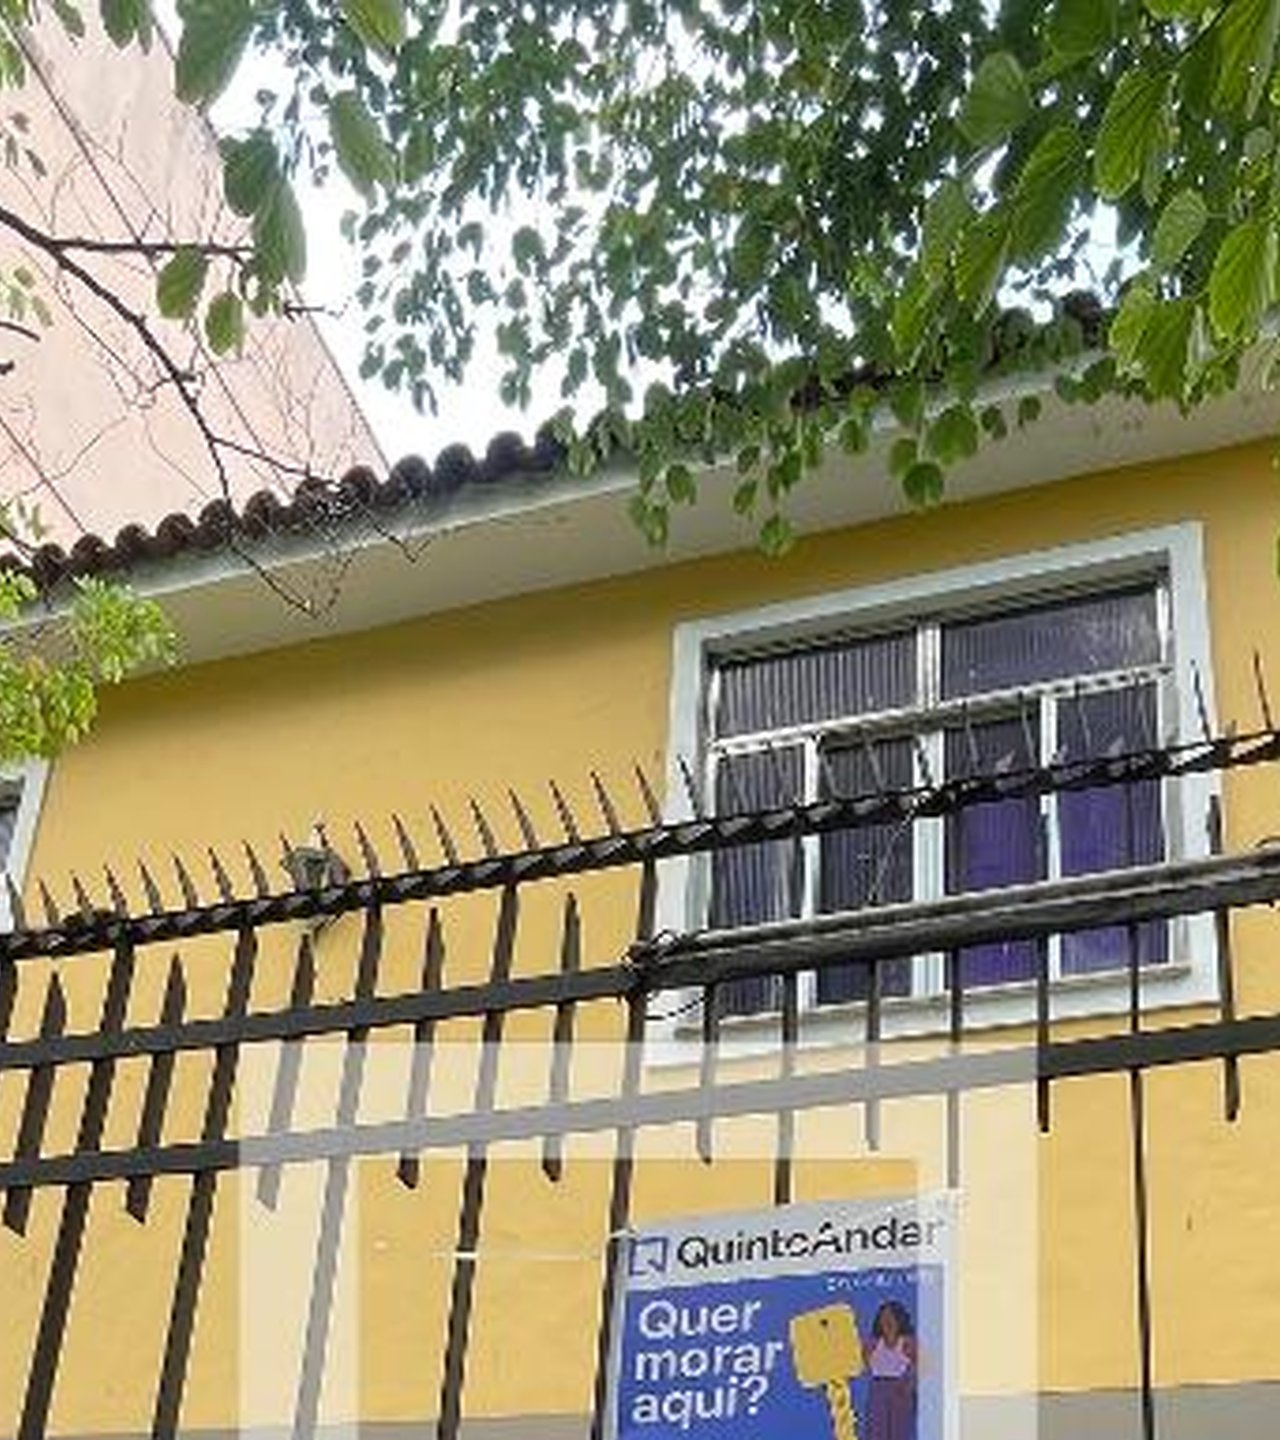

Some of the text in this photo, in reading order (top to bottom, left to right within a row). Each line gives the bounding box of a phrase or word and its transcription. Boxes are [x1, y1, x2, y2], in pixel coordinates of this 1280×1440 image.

[677, 1217, 944, 1270] QuintoAndar
[639, 1299, 761, 1340] Quer
[635, 1340, 783, 1382] morar
[632, 1376, 770, 1429] aqui?
